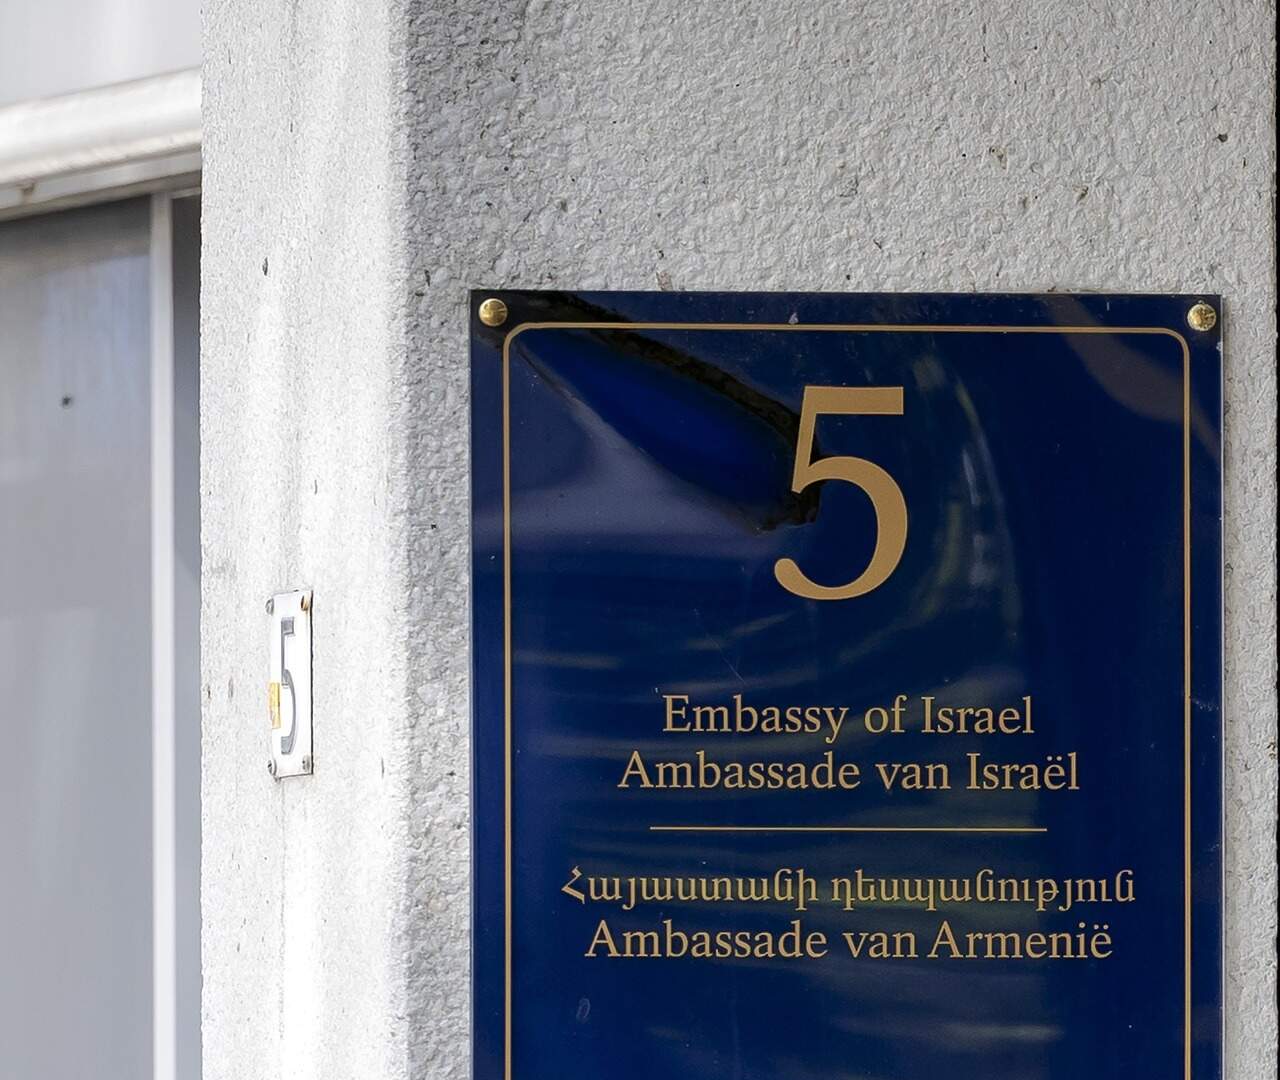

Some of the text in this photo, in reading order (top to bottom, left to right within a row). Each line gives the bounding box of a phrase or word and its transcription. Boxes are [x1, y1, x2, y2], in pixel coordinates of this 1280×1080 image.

[774, 385, 908, 600] 5
[280, 616, 296, 755] 5
[662, 694, 1034, 743] Embassy of Israel
[617, 750, 1080, 790] Ambassade van Israël
[561, 866, 819, 911] Հայաստանի
[584, 919, 1113, 958] Ambassade van Armenië
